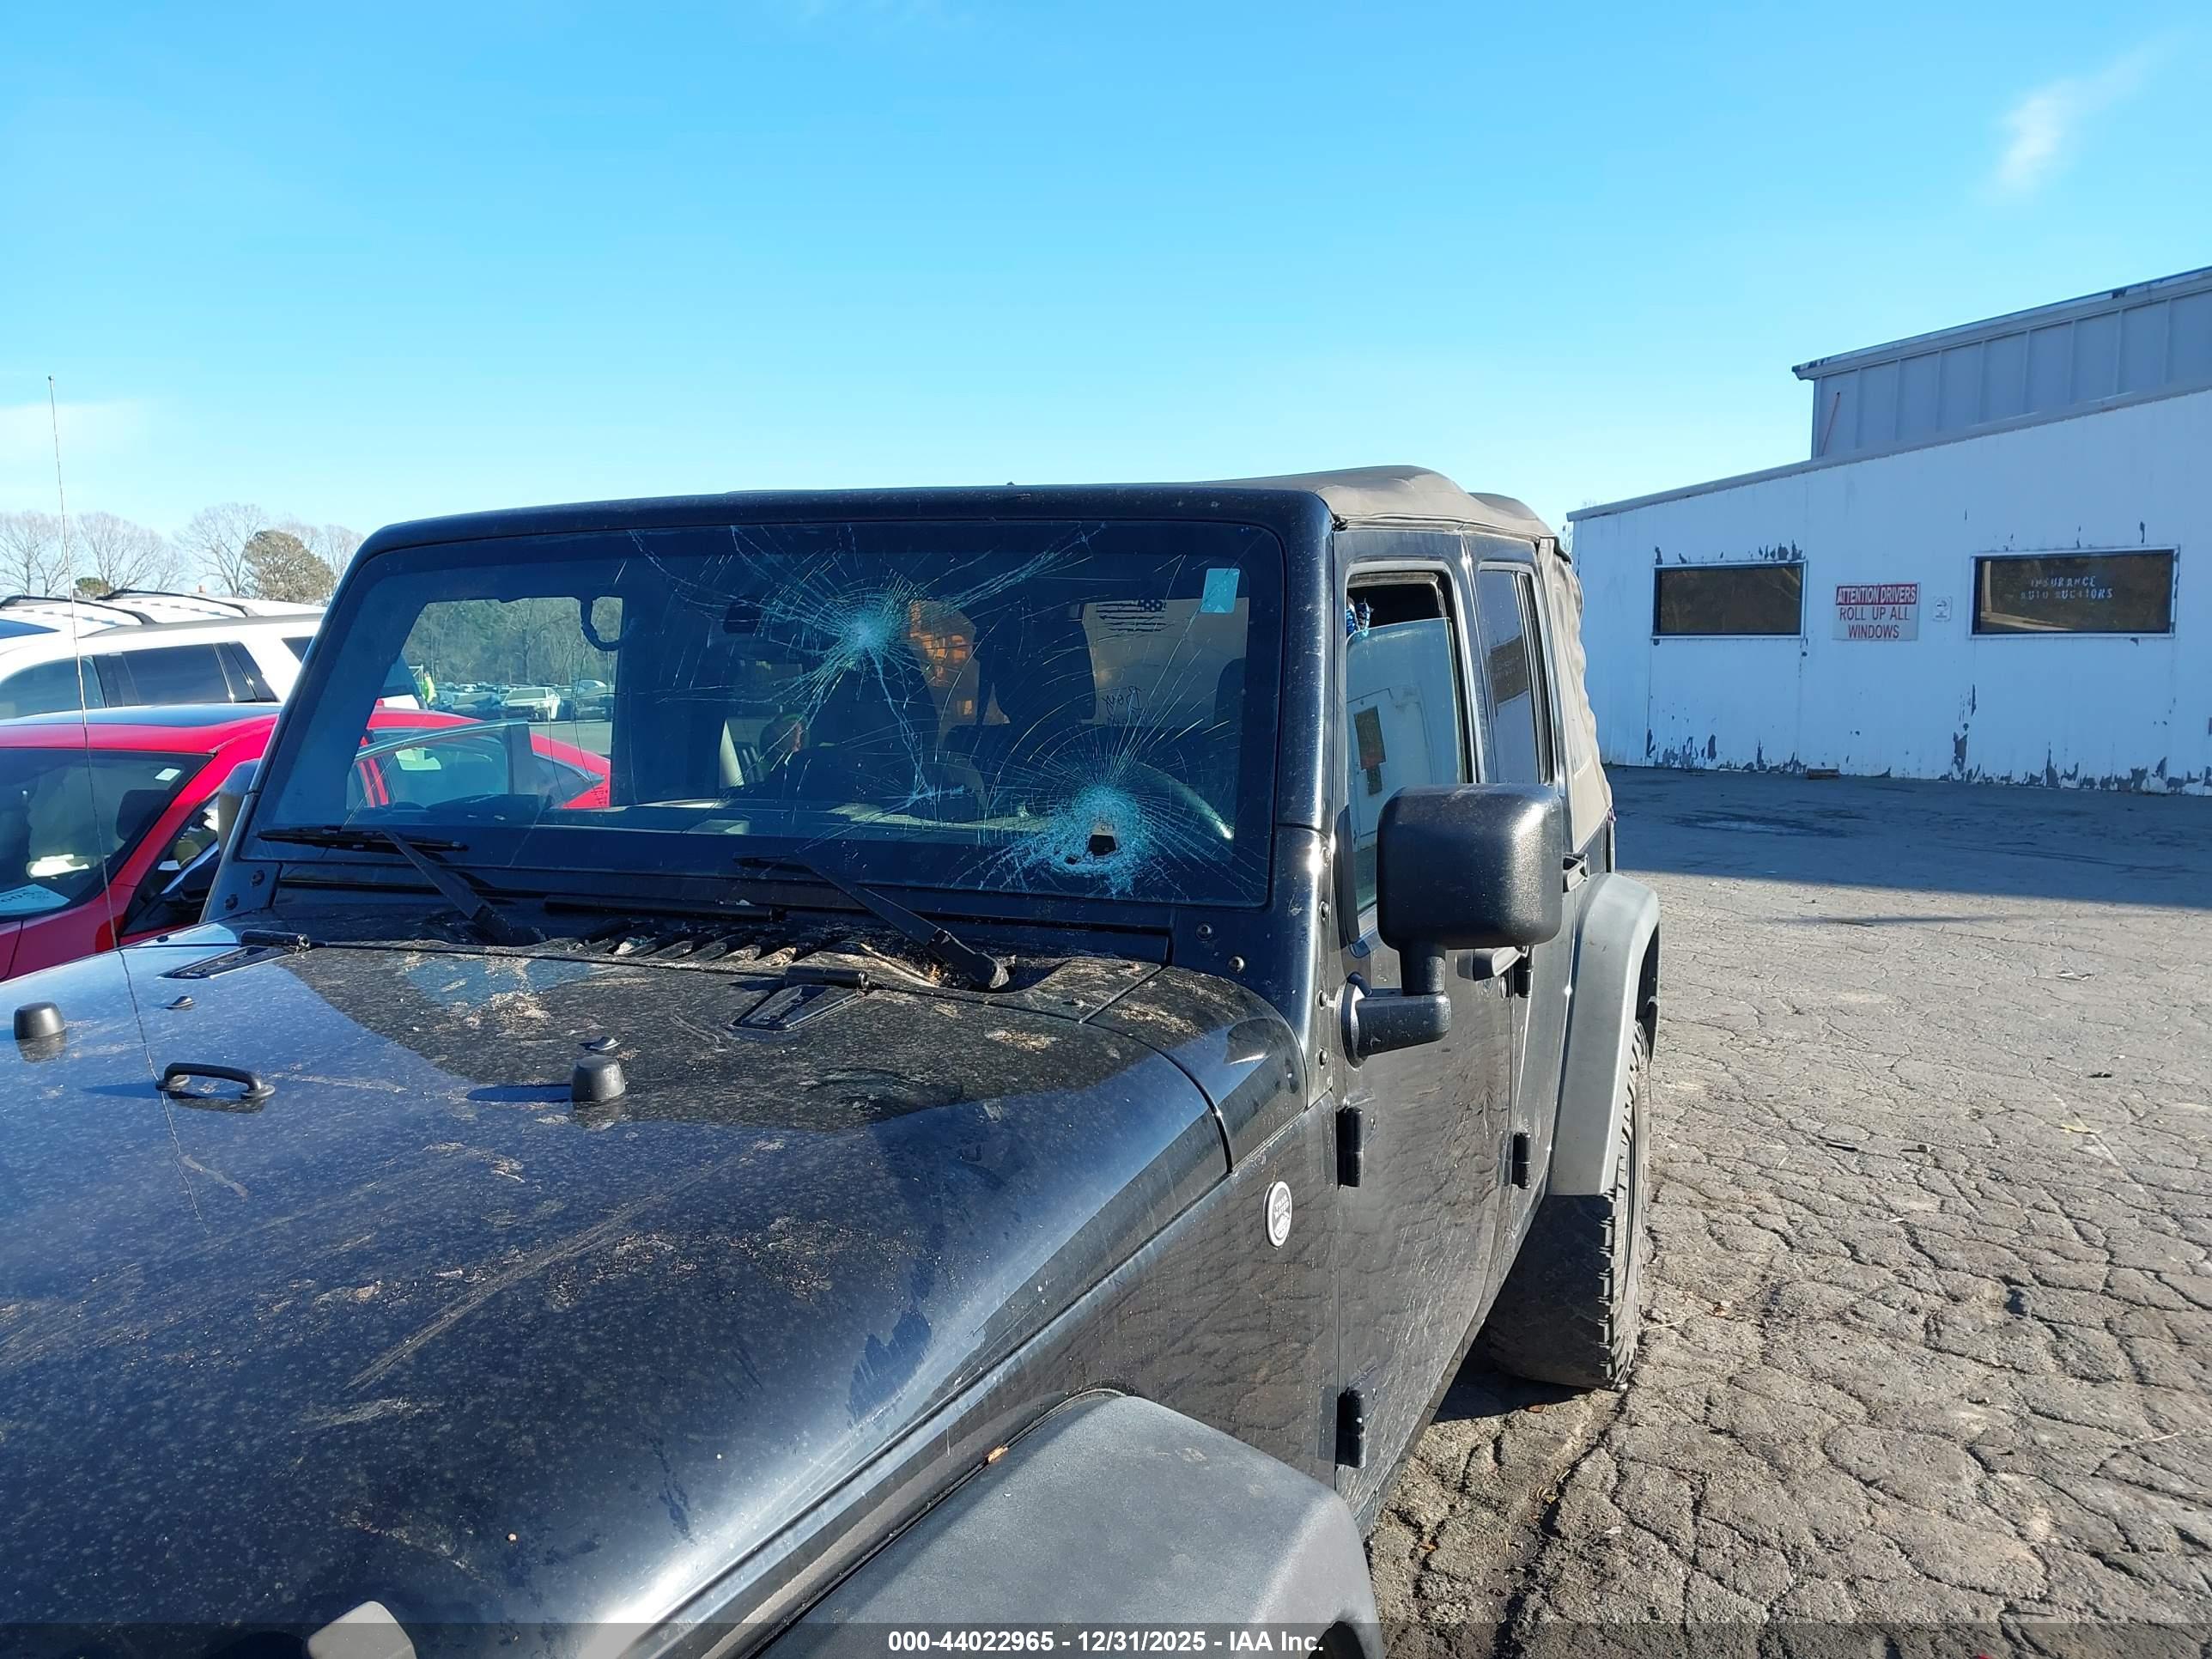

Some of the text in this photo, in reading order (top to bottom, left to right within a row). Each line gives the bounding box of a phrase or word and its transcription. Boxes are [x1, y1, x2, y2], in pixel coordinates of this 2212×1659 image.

[1837, 586, 1917, 605] ATTENTION DRIVERS
[1839, 606, 1910, 621] ROLL UP ALL
[1848, 624, 1899, 639] WINDOWS
